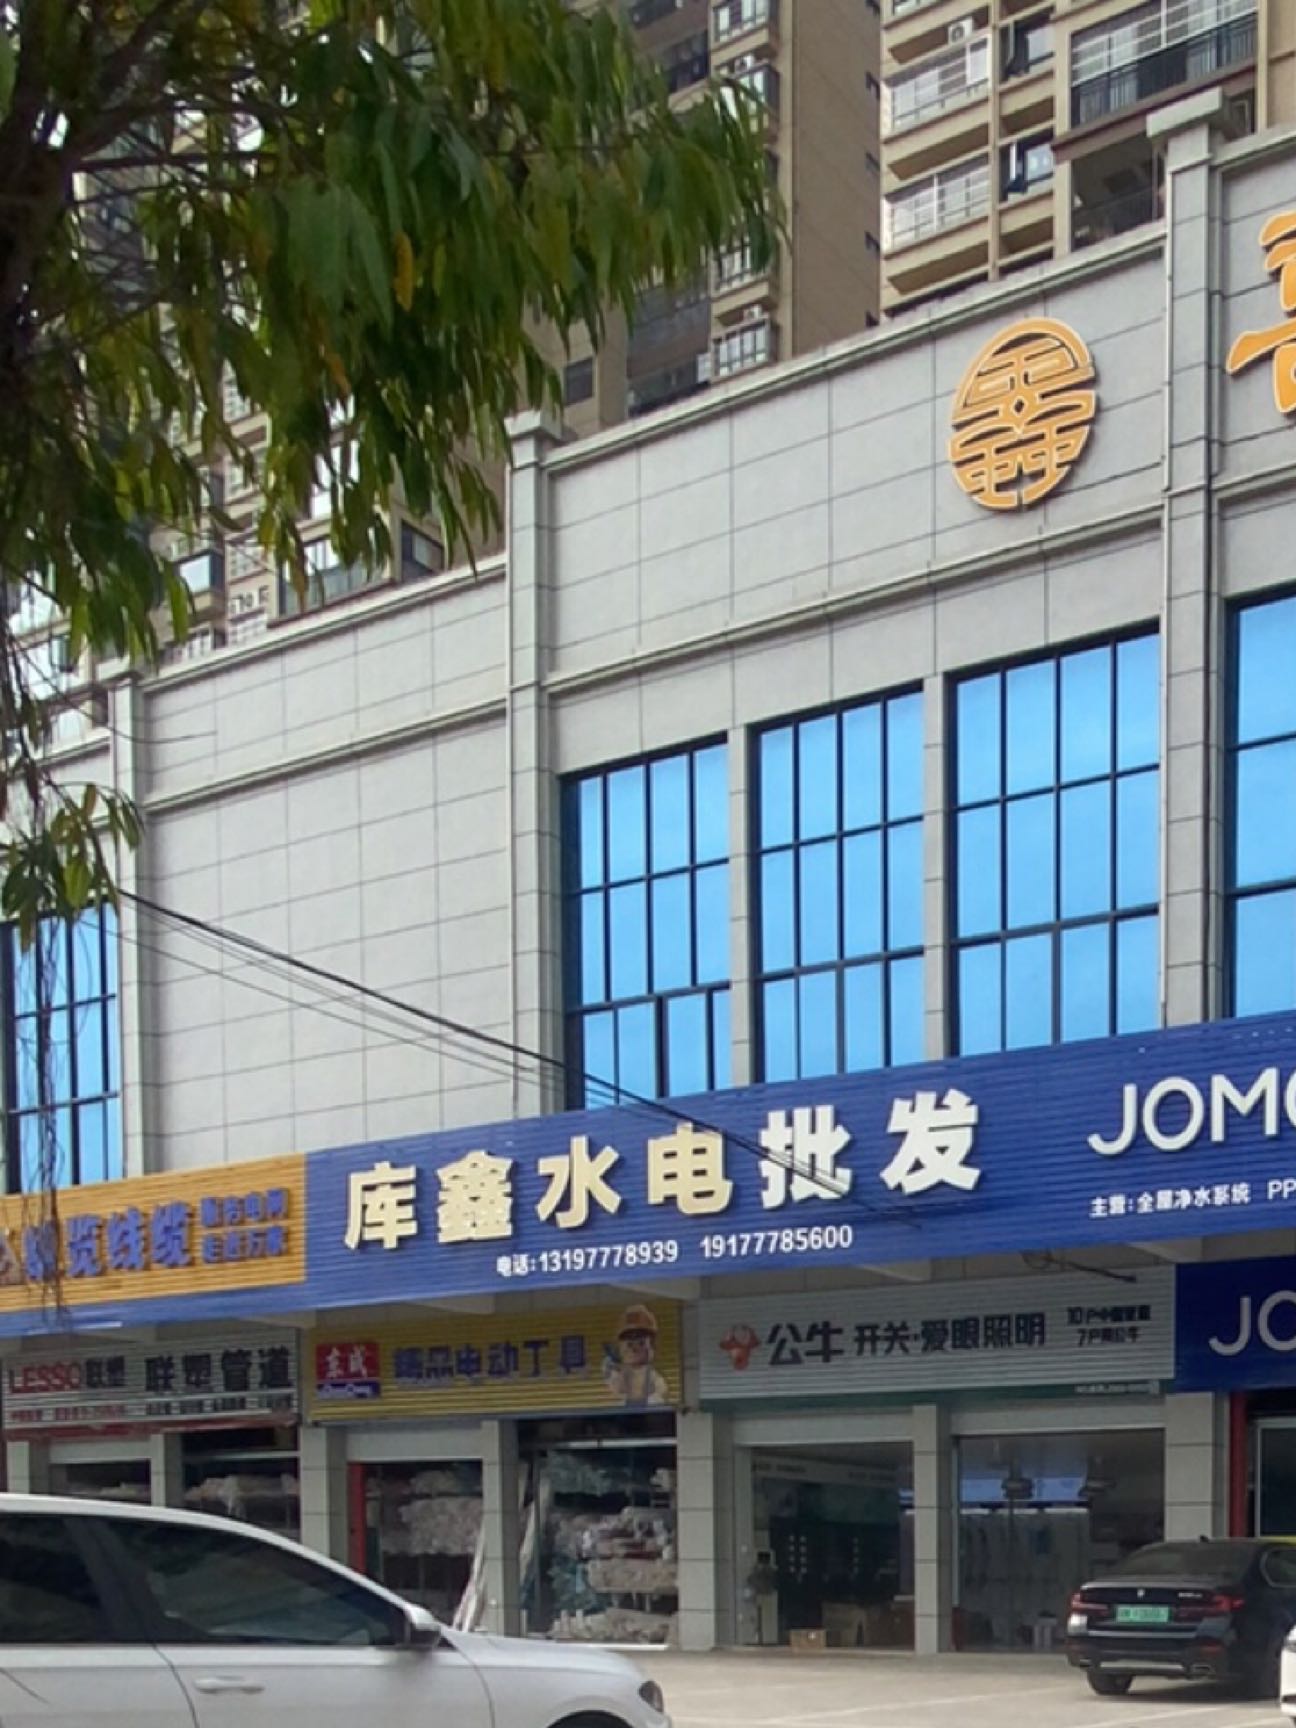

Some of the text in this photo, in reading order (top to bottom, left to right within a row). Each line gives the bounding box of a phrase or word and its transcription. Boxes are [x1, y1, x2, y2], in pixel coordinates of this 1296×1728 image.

[344, 1088, 982, 1250] 库鑫水电批发
[701, 1225, 852, 1258] 19177785600
[767, 1320, 844, 1365] 公牛
[9, 1361, 82, 1393] LESSO
